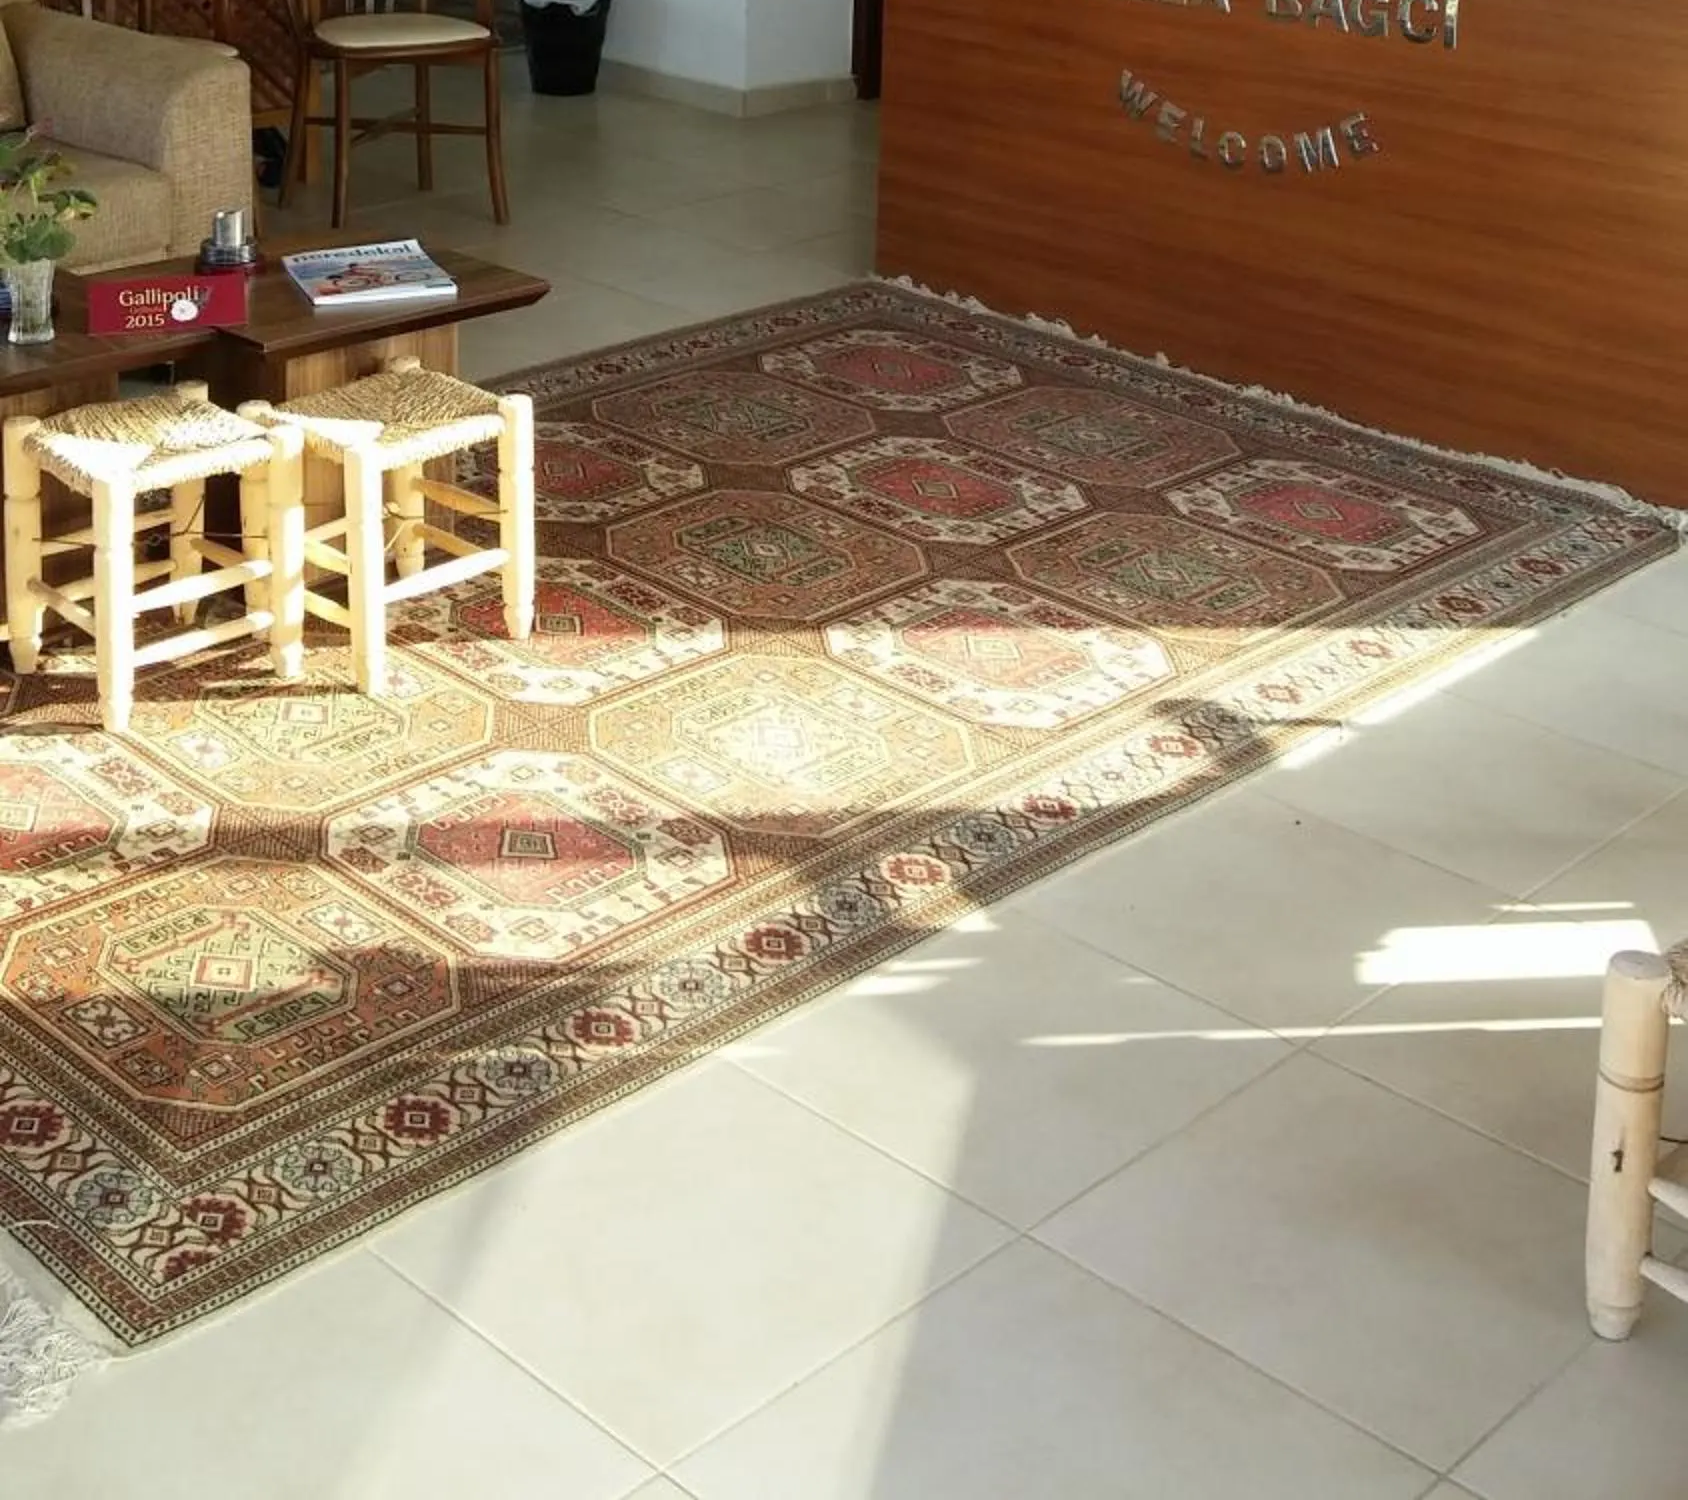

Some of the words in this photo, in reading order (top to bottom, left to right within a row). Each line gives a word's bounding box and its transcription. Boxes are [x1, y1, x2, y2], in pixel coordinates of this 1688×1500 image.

[1118, 68, 1381, 175] WELCOME
[118, 284, 199, 313] Gallipoli
[125, 313, 166, 329] 2015
